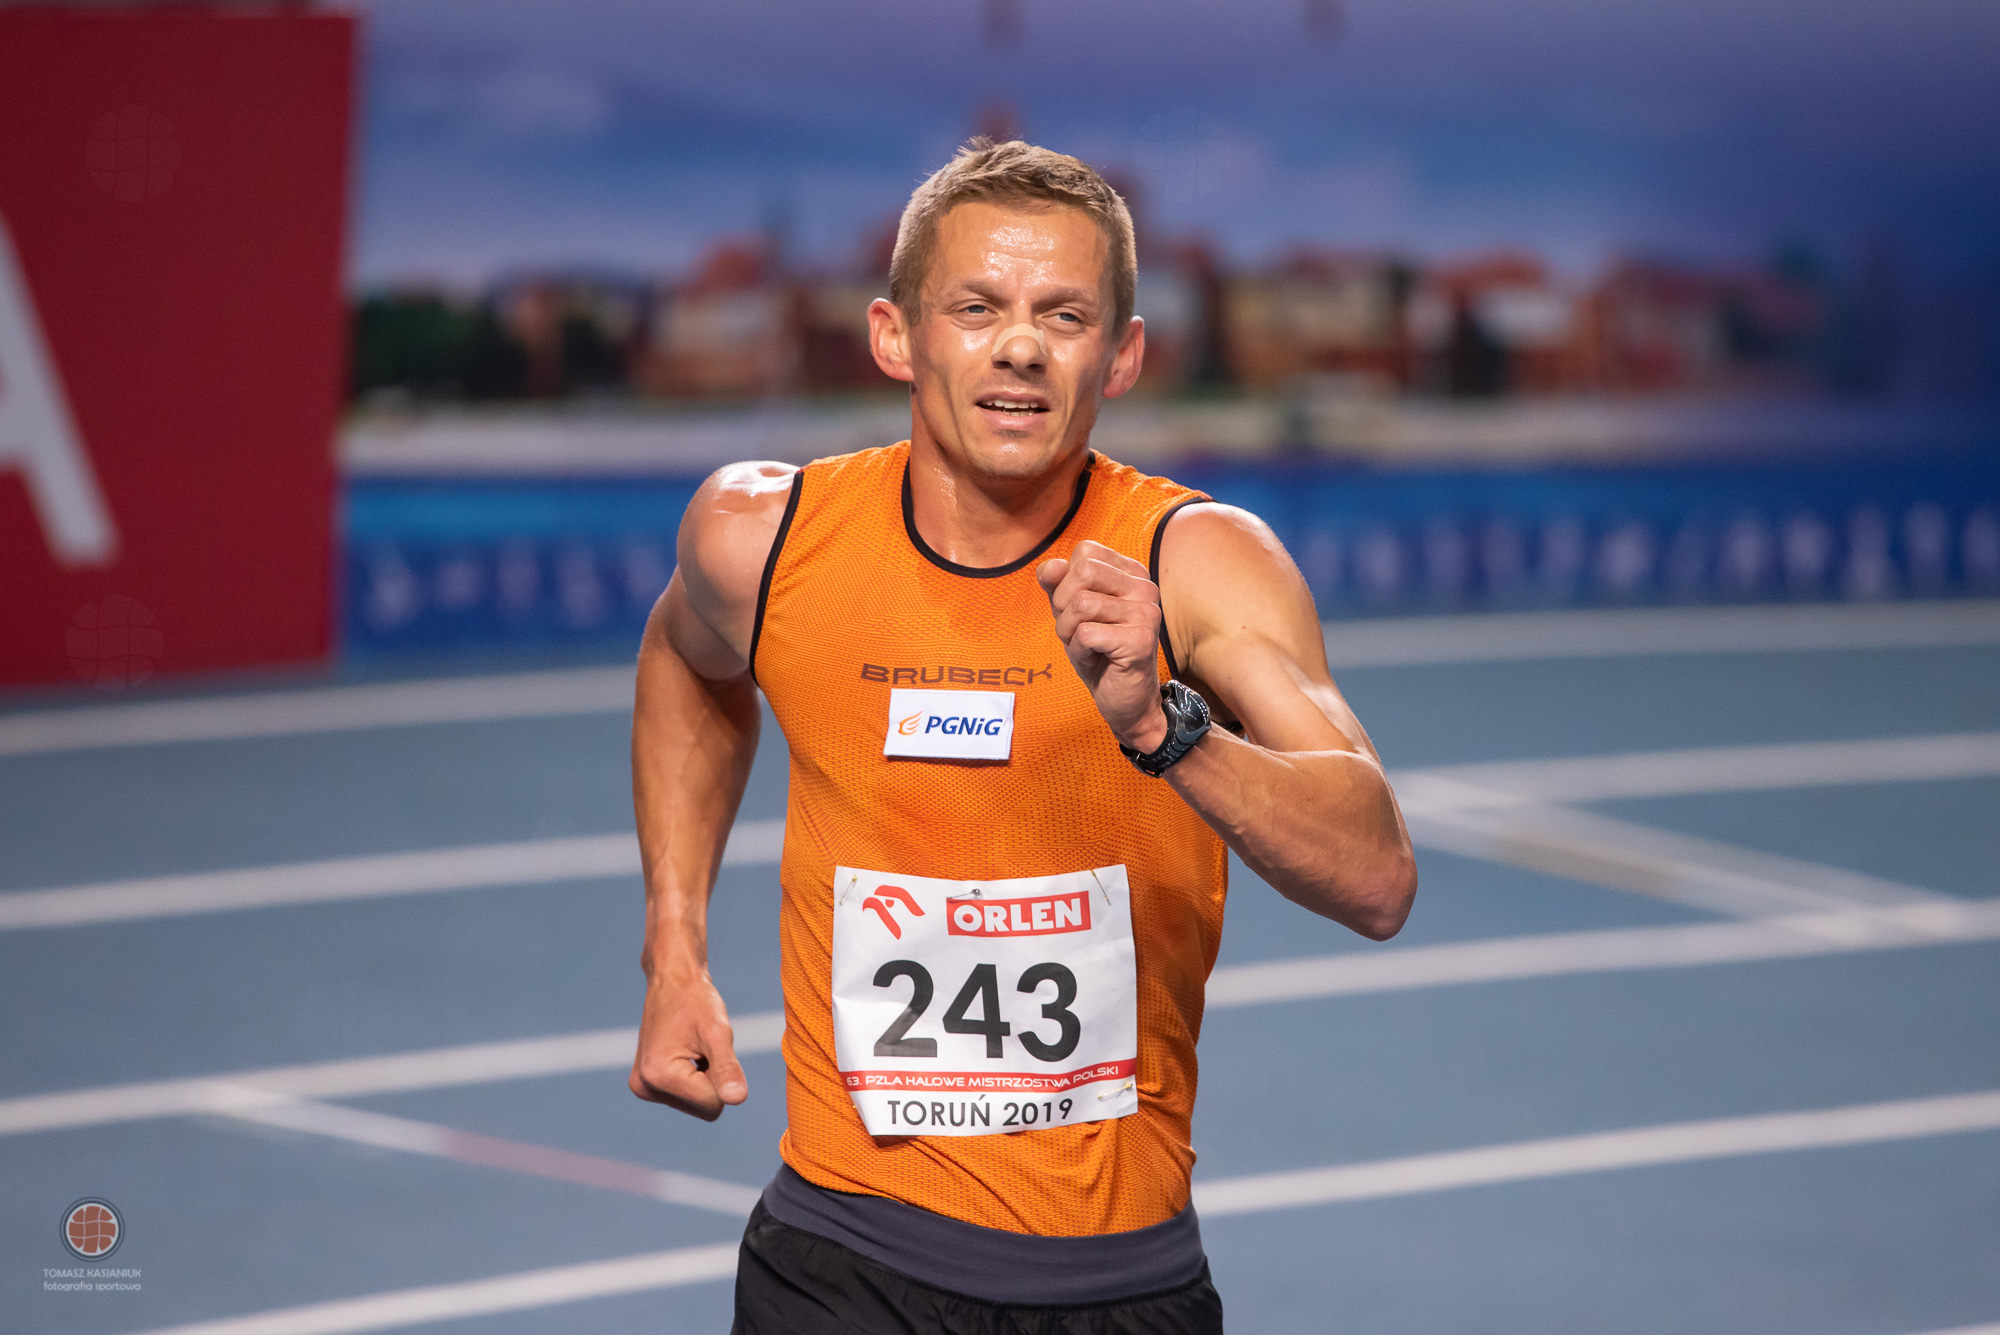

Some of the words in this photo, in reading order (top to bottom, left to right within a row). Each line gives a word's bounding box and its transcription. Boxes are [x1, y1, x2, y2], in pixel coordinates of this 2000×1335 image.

[861, 663, 1052, 686] BRUBECK
[925, 716, 1003, 736] PGNiG
[953, 898, 1082, 933] ORLEN
[873, 960, 1081, 1062] 243
[846, 1076, 862, 1086] 63.
[865, 1075, 903, 1086] PZLA
[906, 1076, 965, 1087] HALOWE
[968, 1077, 1071, 1088] MISTRZOSTWA
[1073, 1066, 1119, 1083] POLSKI
[887, 1094, 990, 1127] TORUŃ
[1003, 1098, 1073, 1126] 2019
